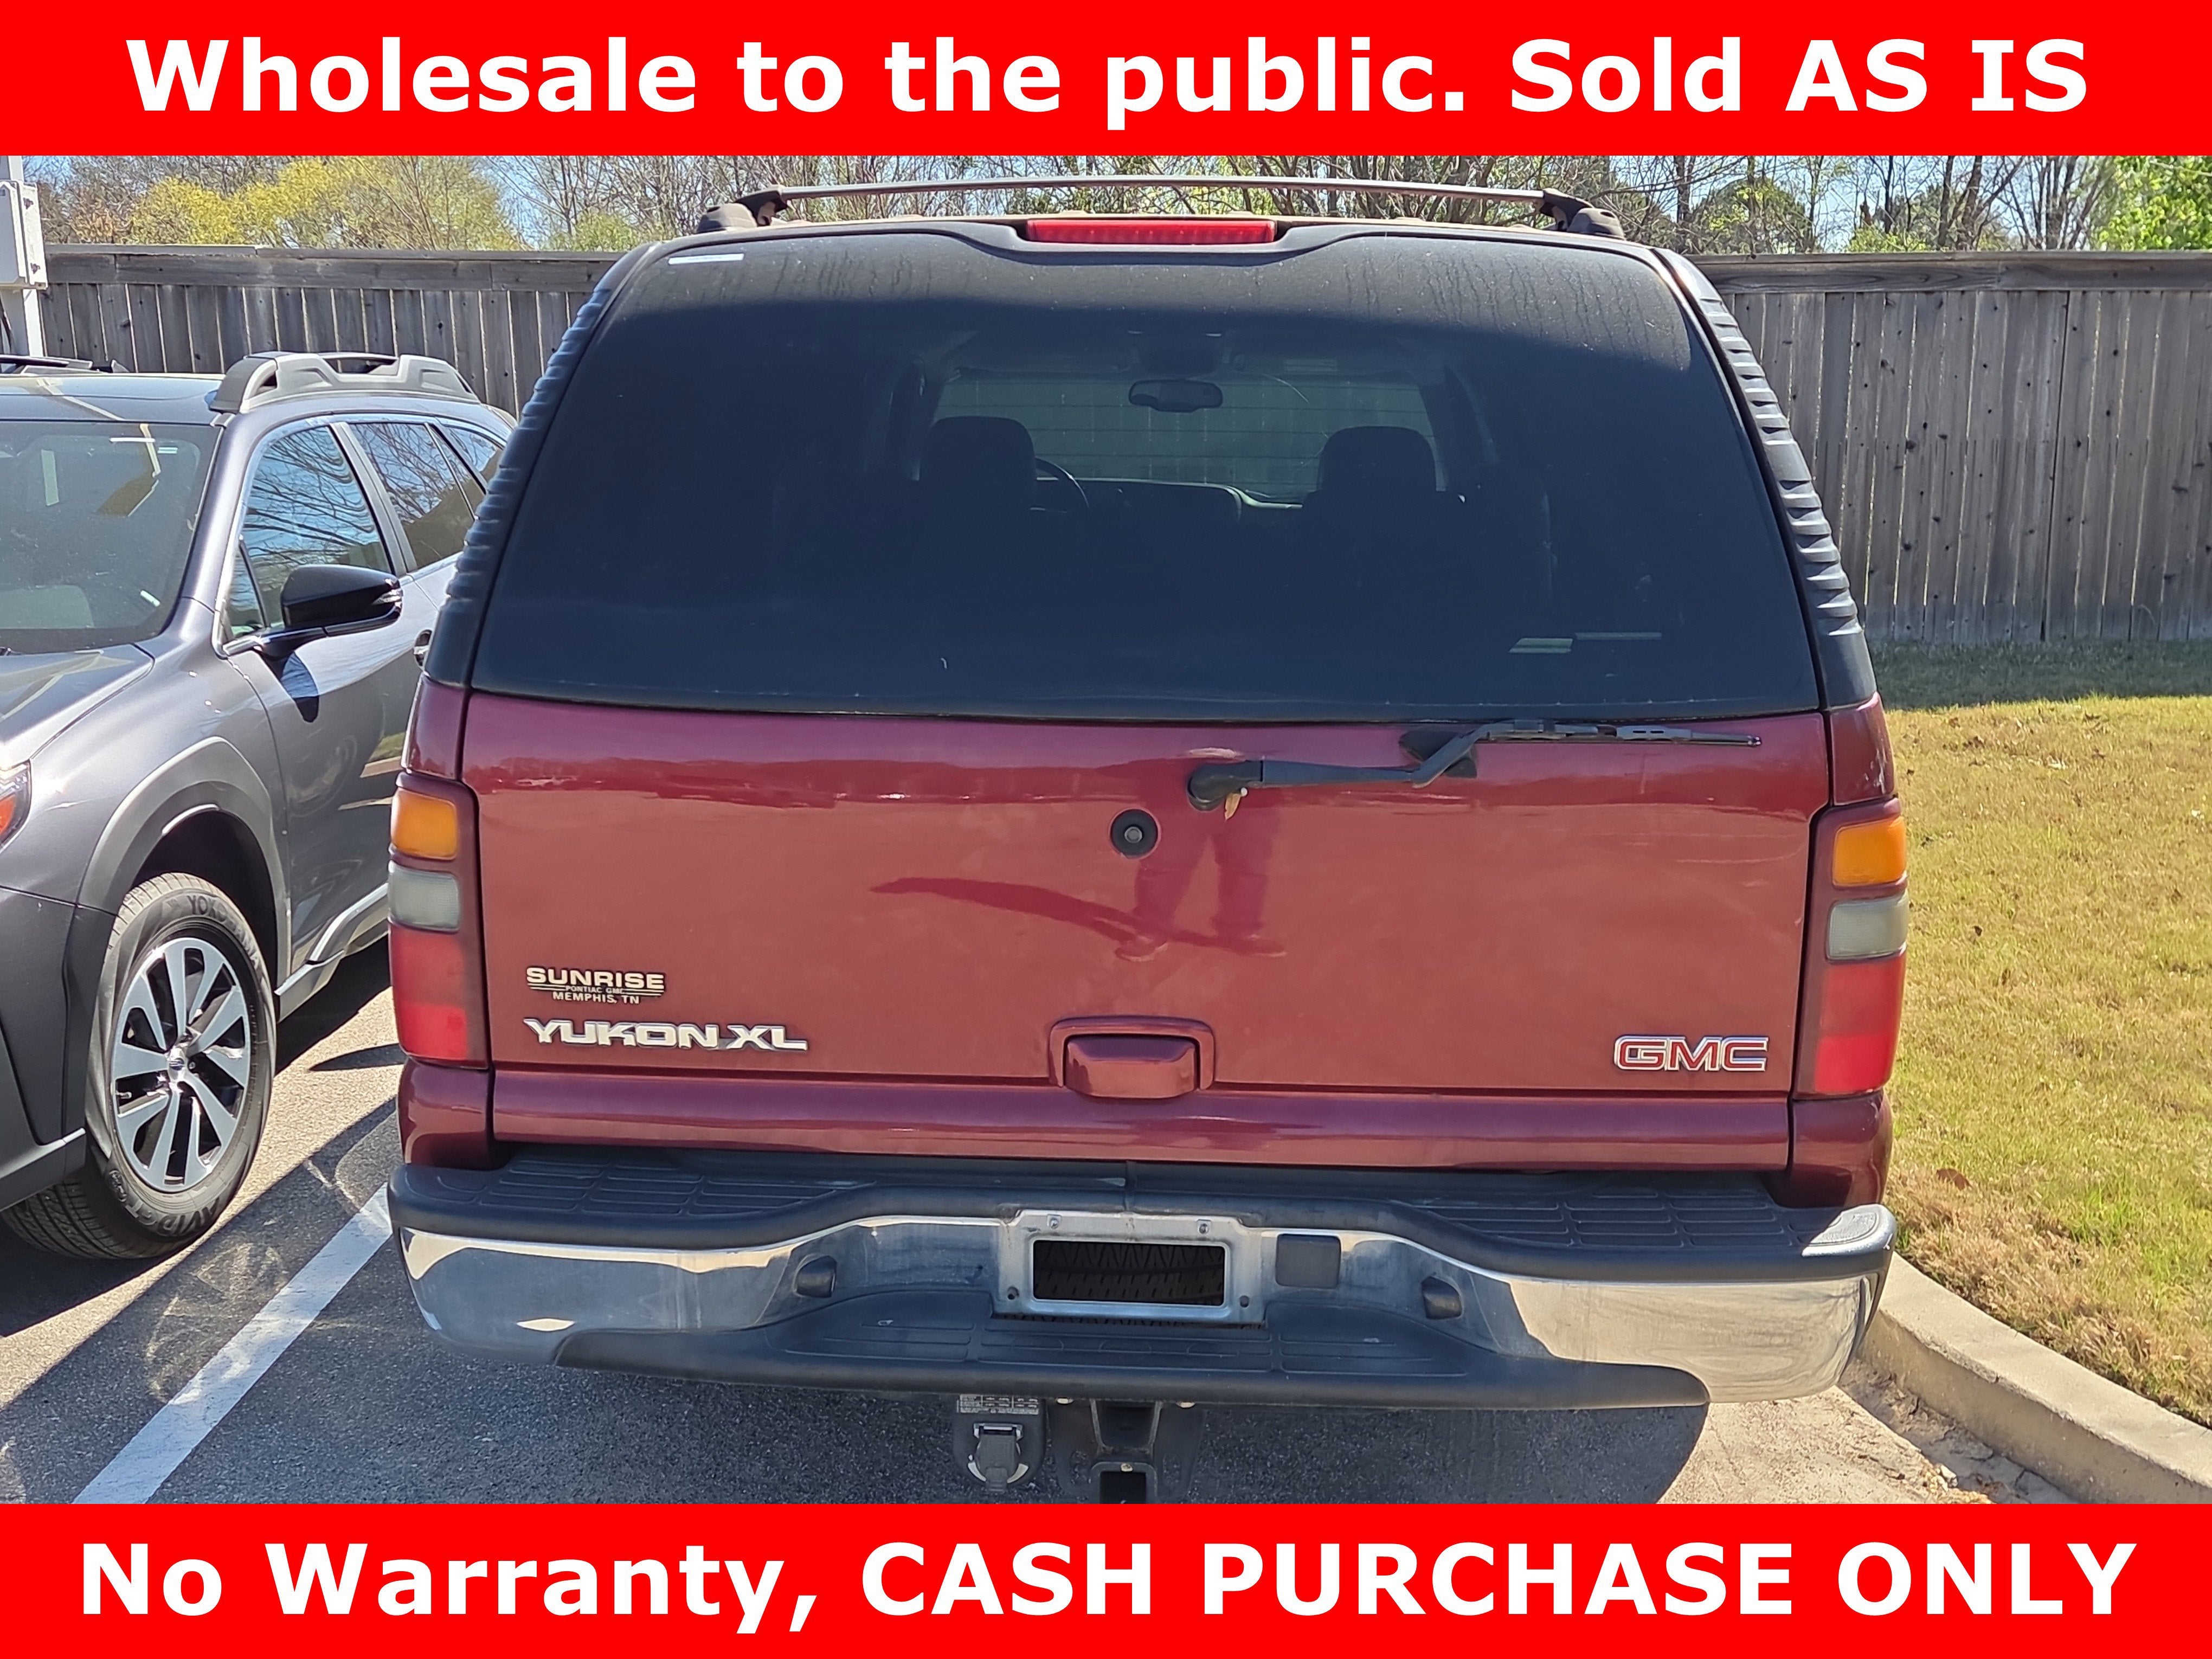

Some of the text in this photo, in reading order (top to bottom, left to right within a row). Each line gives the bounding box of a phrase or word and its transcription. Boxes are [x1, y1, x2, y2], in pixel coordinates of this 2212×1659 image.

[526, 967, 665, 989] SUNRISE
[552, 991, 640, 1004] MEMPHIS, TN
[565, 985, 602, 993] PONTIAC
[1613, 1035, 1769, 1072] GMC
